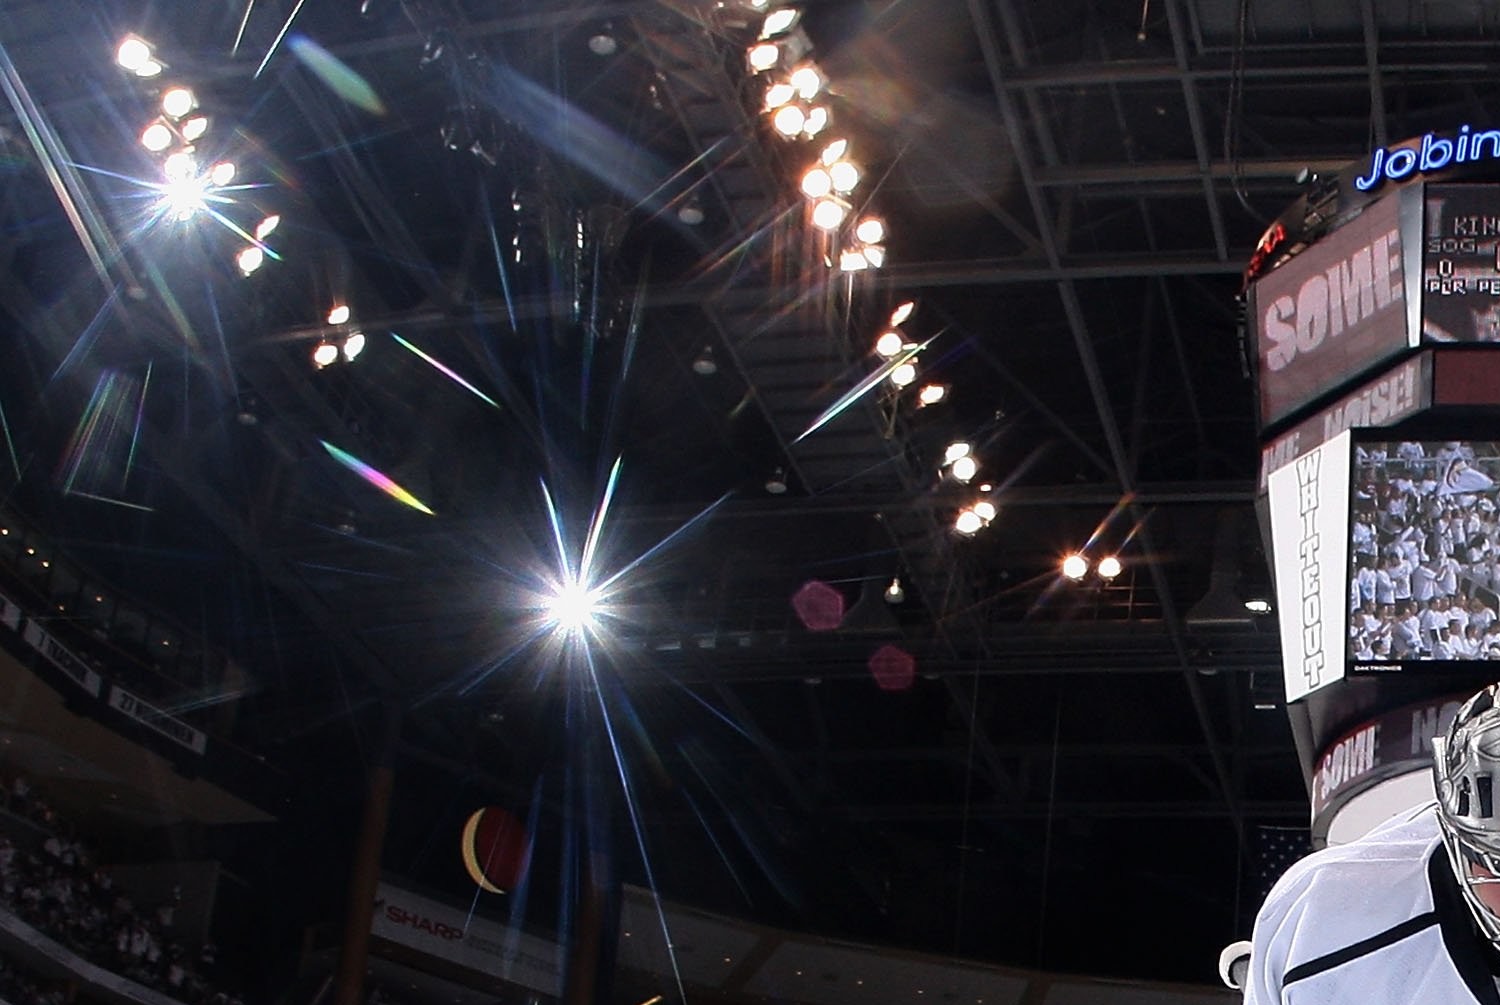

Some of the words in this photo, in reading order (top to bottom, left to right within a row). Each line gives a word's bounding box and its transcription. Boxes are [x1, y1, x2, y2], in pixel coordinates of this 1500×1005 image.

[1428, 238, 1475, 253] SOG
[1265, 229, 1403, 371] SOME
[1430, 280, 1466, 295] PLR
[1296, 449, 1325, 690] WHITEOUT
[385, 905, 464, 941] SHARP
